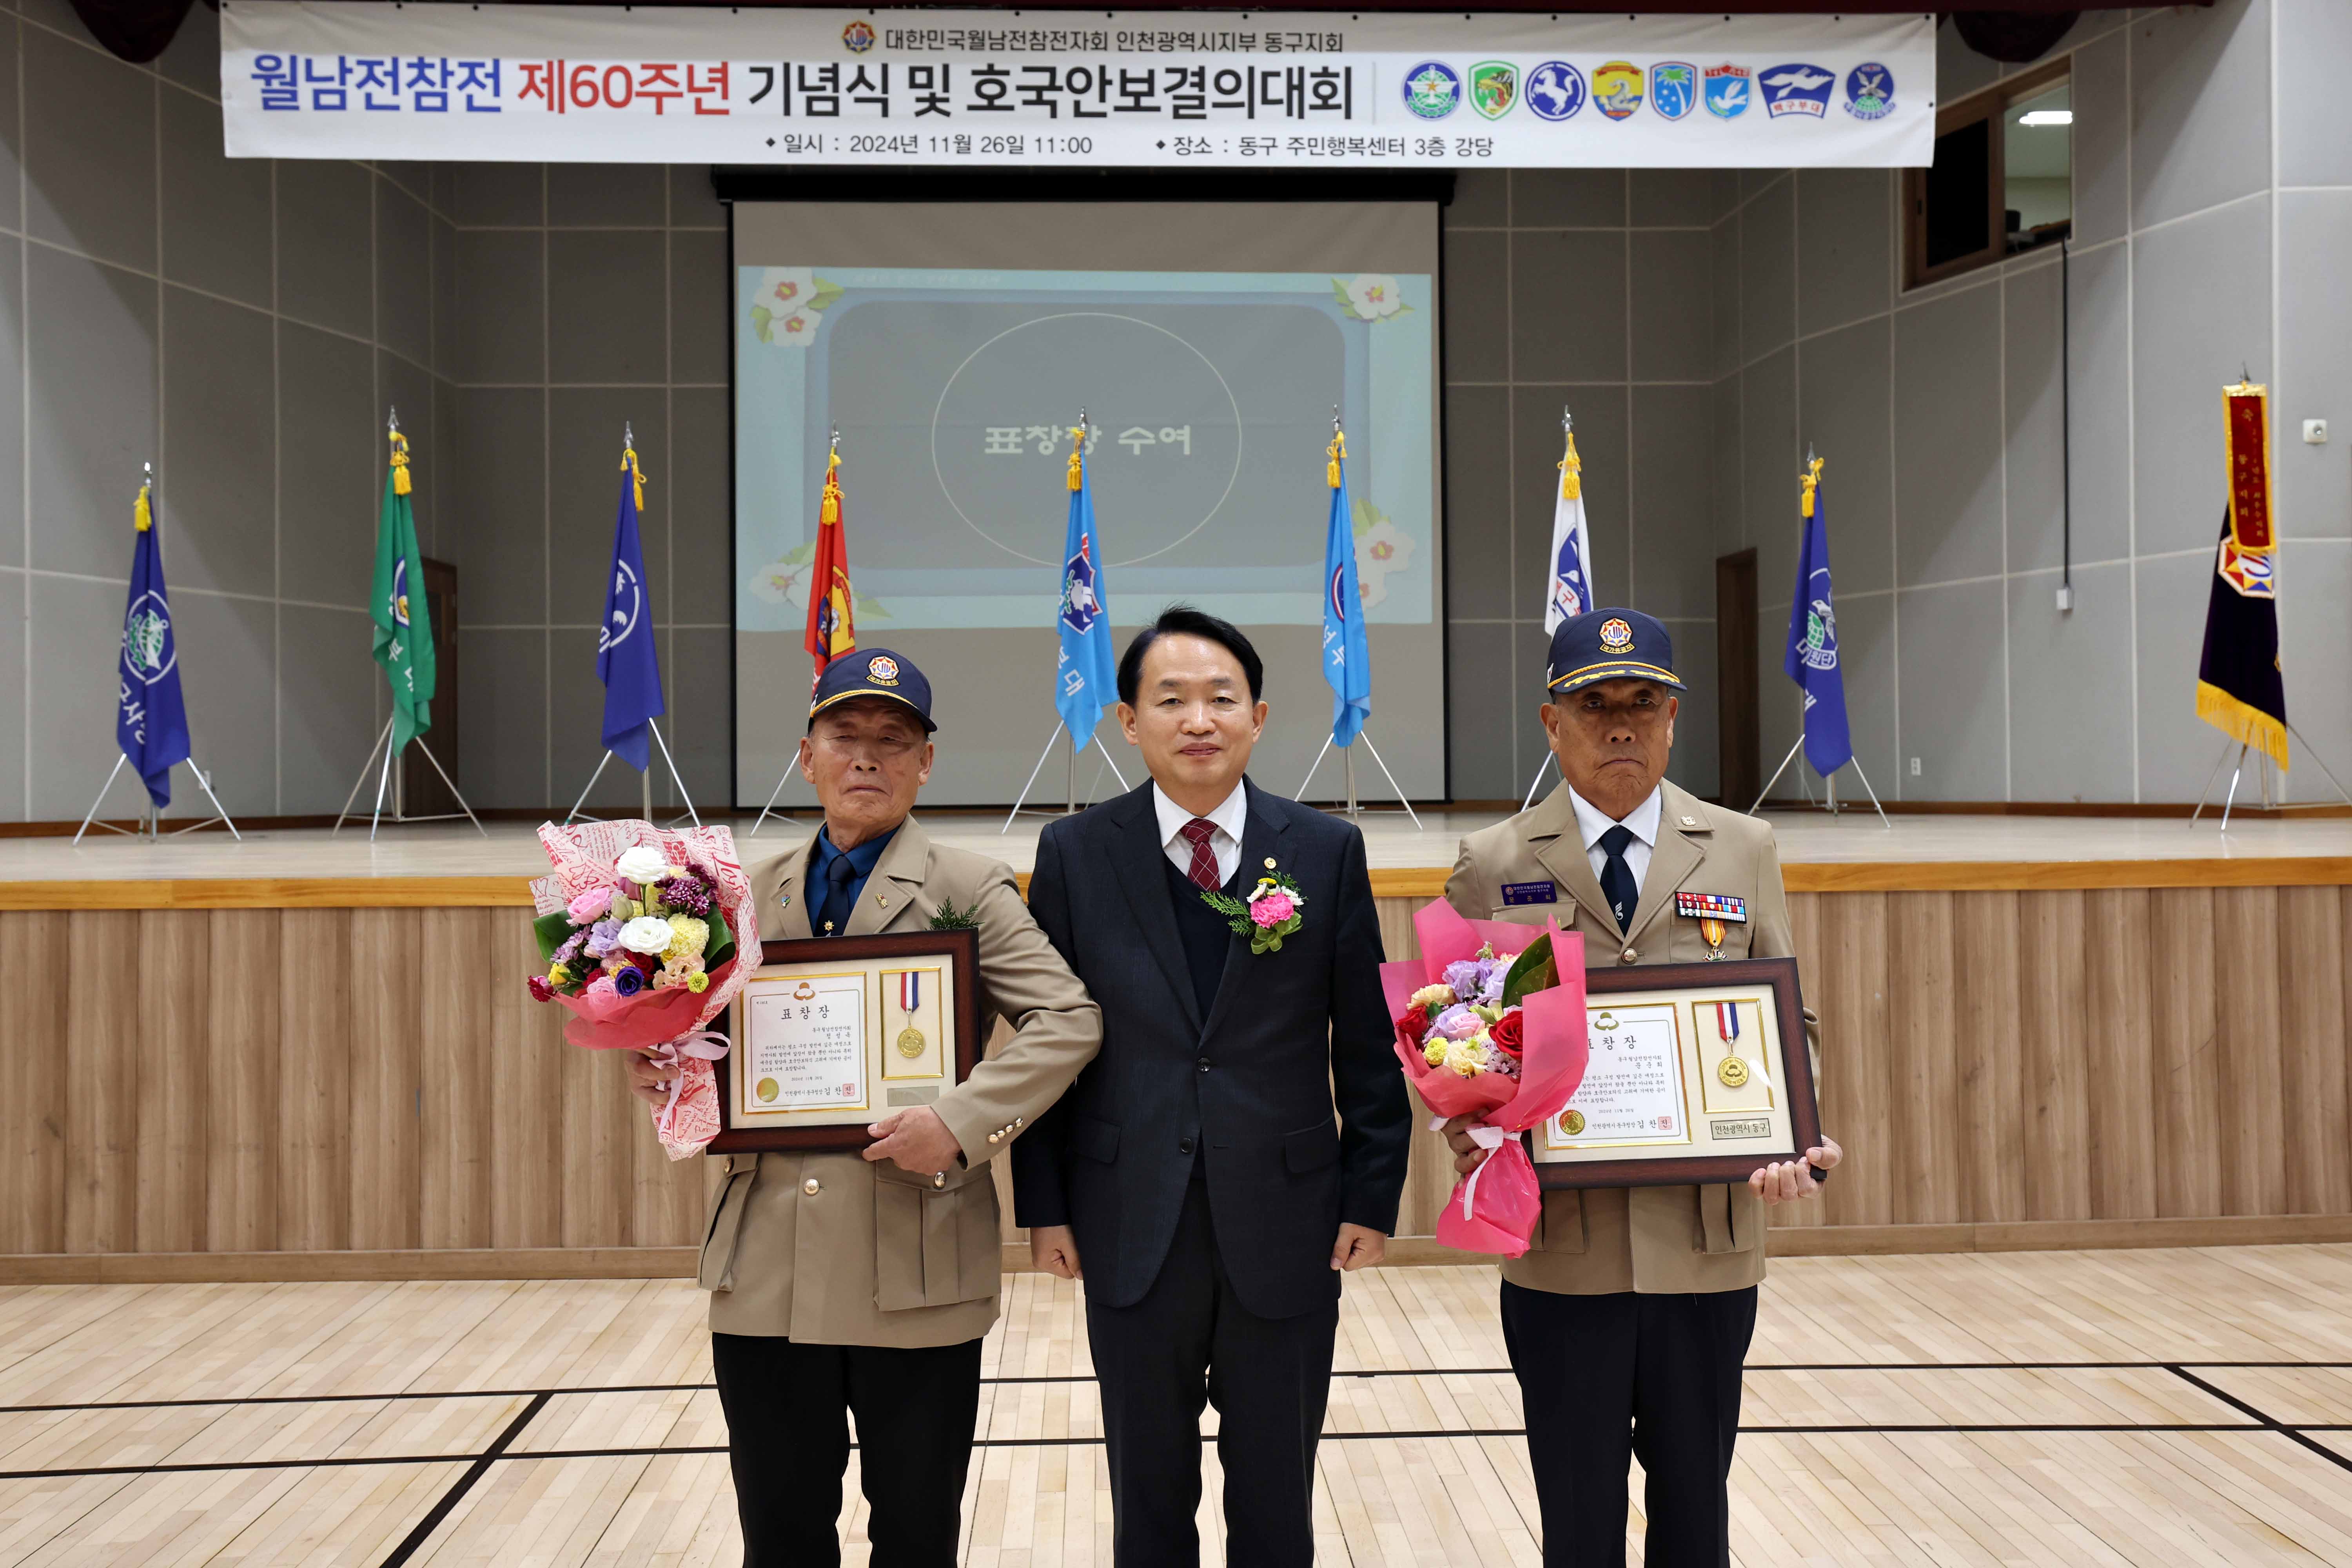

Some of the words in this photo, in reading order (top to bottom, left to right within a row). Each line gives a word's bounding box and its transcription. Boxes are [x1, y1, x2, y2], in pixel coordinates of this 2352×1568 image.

[886, 29, 1109, 52] 대한민국월남전참전자회
[1116, 30, 1257, 53] 인천광역시지부
[1264, 31, 1344, 53] 동구지회
[250, 54, 502, 113] 월남전참전
[517, 58, 730, 115] 제60주년
[749, 62, 889, 118] 기념식
[908, 63, 951, 118] 및
[967, 63, 1352, 120] 호국안보결의대회
[784, 134, 823, 154] 일시
[850, 134, 918, 154] 2024년
[929, 134, 971, 154] 11월
[980, 134, 1024, 155] 26일
[1034, 136, 1093, 154] 11:00
[1173, 136, 1212, 156] 장소
[1238, 137, 1279, 156] 동구
[1286, 136, 1405, 157] 주민행복센터
[1414, 137, 1446, 157] 3층
[1455, 137, 1494, 158] 강당
[1118, 425, 1191, 456] 수여
[1715, 1123, 1750, 1135] 인천광역시
[1752, 1123, 1766, 1133] 동구
